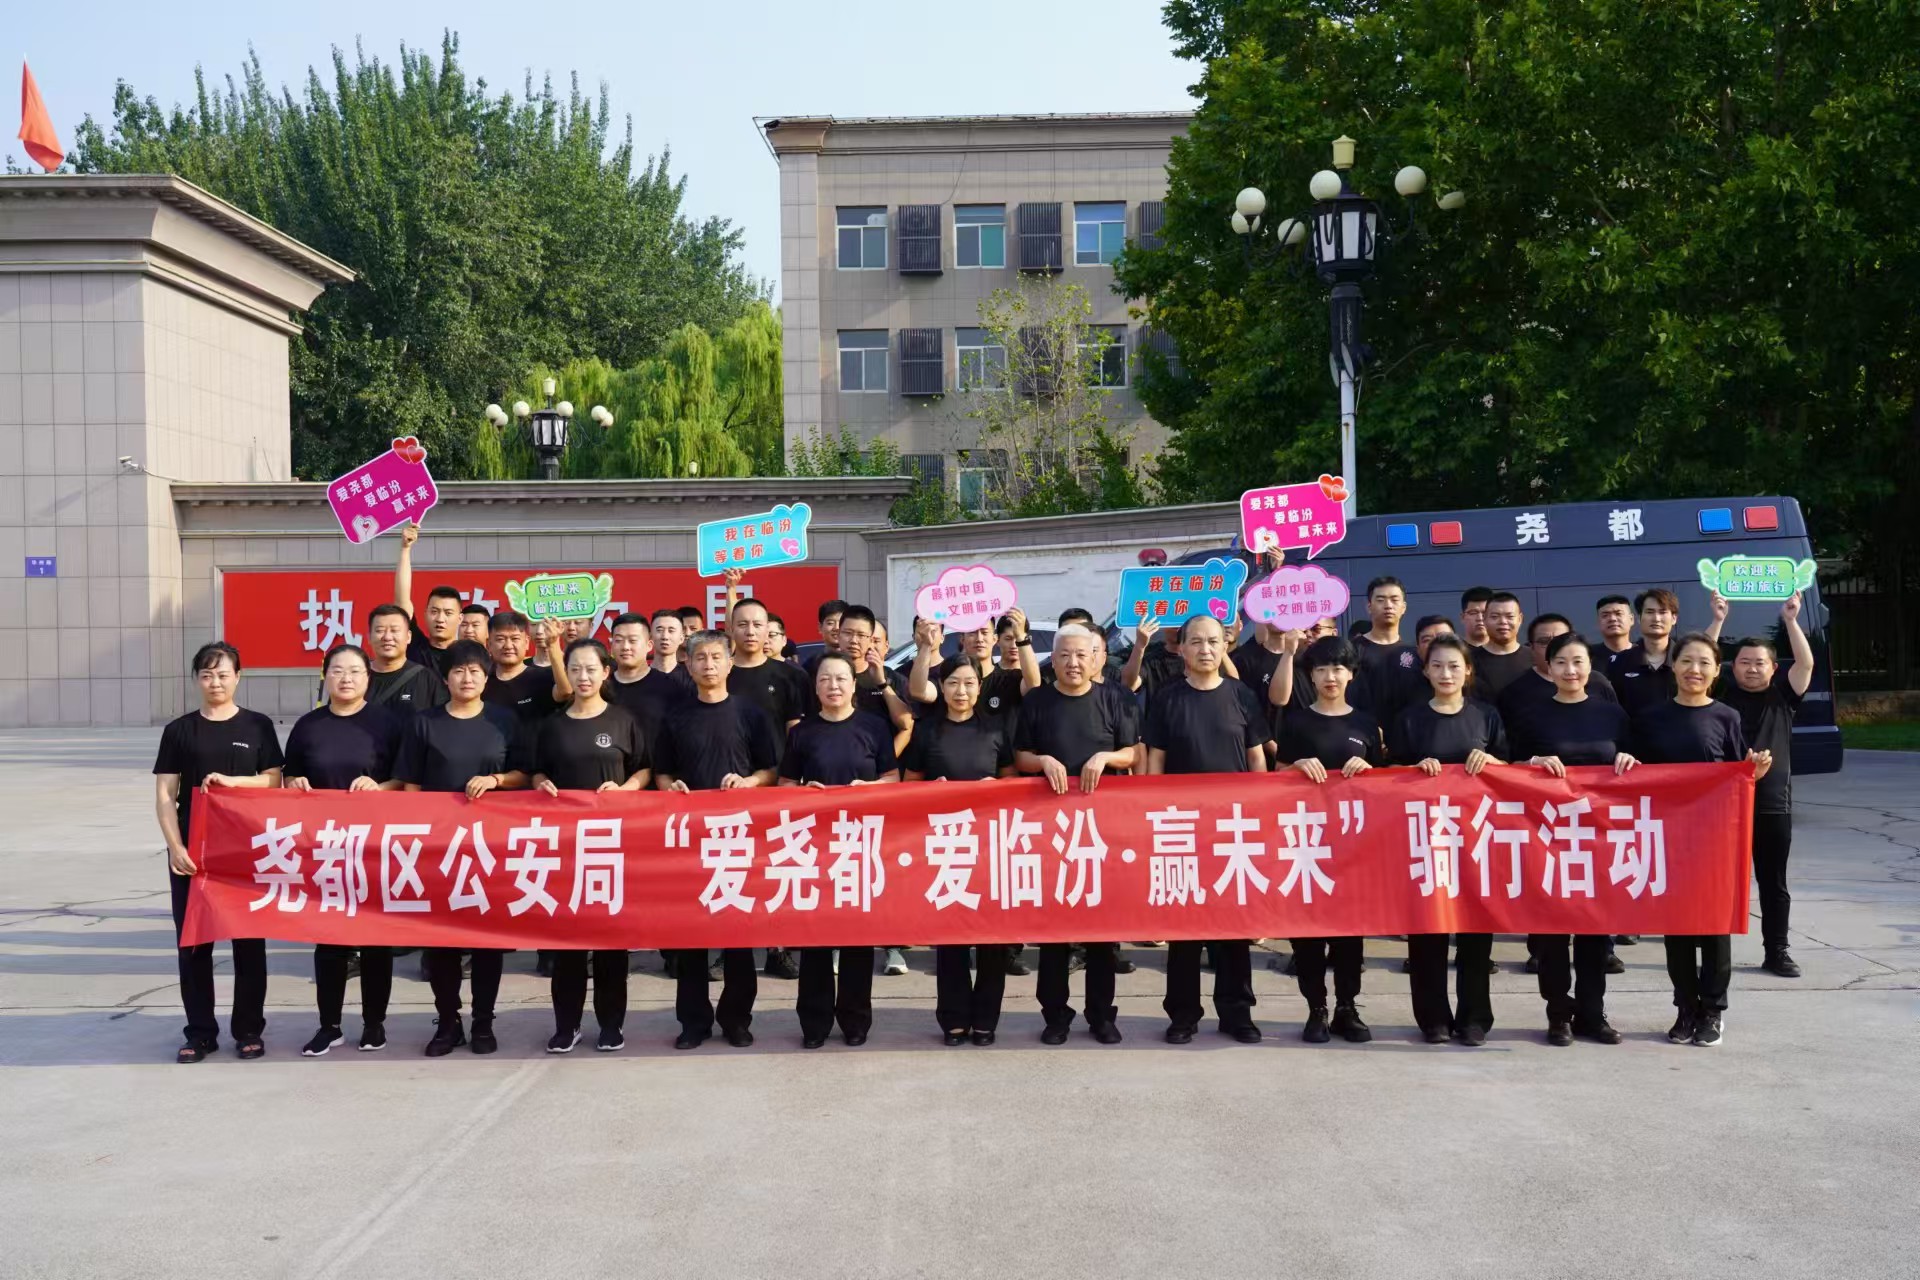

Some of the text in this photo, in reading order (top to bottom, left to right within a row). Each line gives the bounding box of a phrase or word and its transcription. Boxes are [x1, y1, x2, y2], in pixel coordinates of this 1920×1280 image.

[336, 473, 374, 502] 爱尧都
[364, 480, 402, 508] 爱临汾
[391, 485, 430, 515] 赢未来
[1250, 494, 1289, 511] 爱尧都
[1274, 508, 1313, 525] 爱临汾
[724, 518, 792, 542] 我在临汾
[1298, 522, 1338, 539] 赢未来
[1515, 508, 1644, 546] 尧都
[714, 544, 764, 564] 等着你
[1734, 564, 1778, 577] 欢迎来
[539, 582, 580, 597] 欢迎来
[931, 582, 985, 601] 最初中国
[1149, 576, 1224, 593] 我在临汾
[1261, 582, 1316, 599] 最初中国
[1726, 581, 1786, 593] 临汾旅行
[533, 599, 588, 614] 临汾旅行
[948, 598, 1001, 617] 文明临汾
[1134, 600, 1189, 617] 等着你
[1277, 600, 1333, 616] 文明临汾
